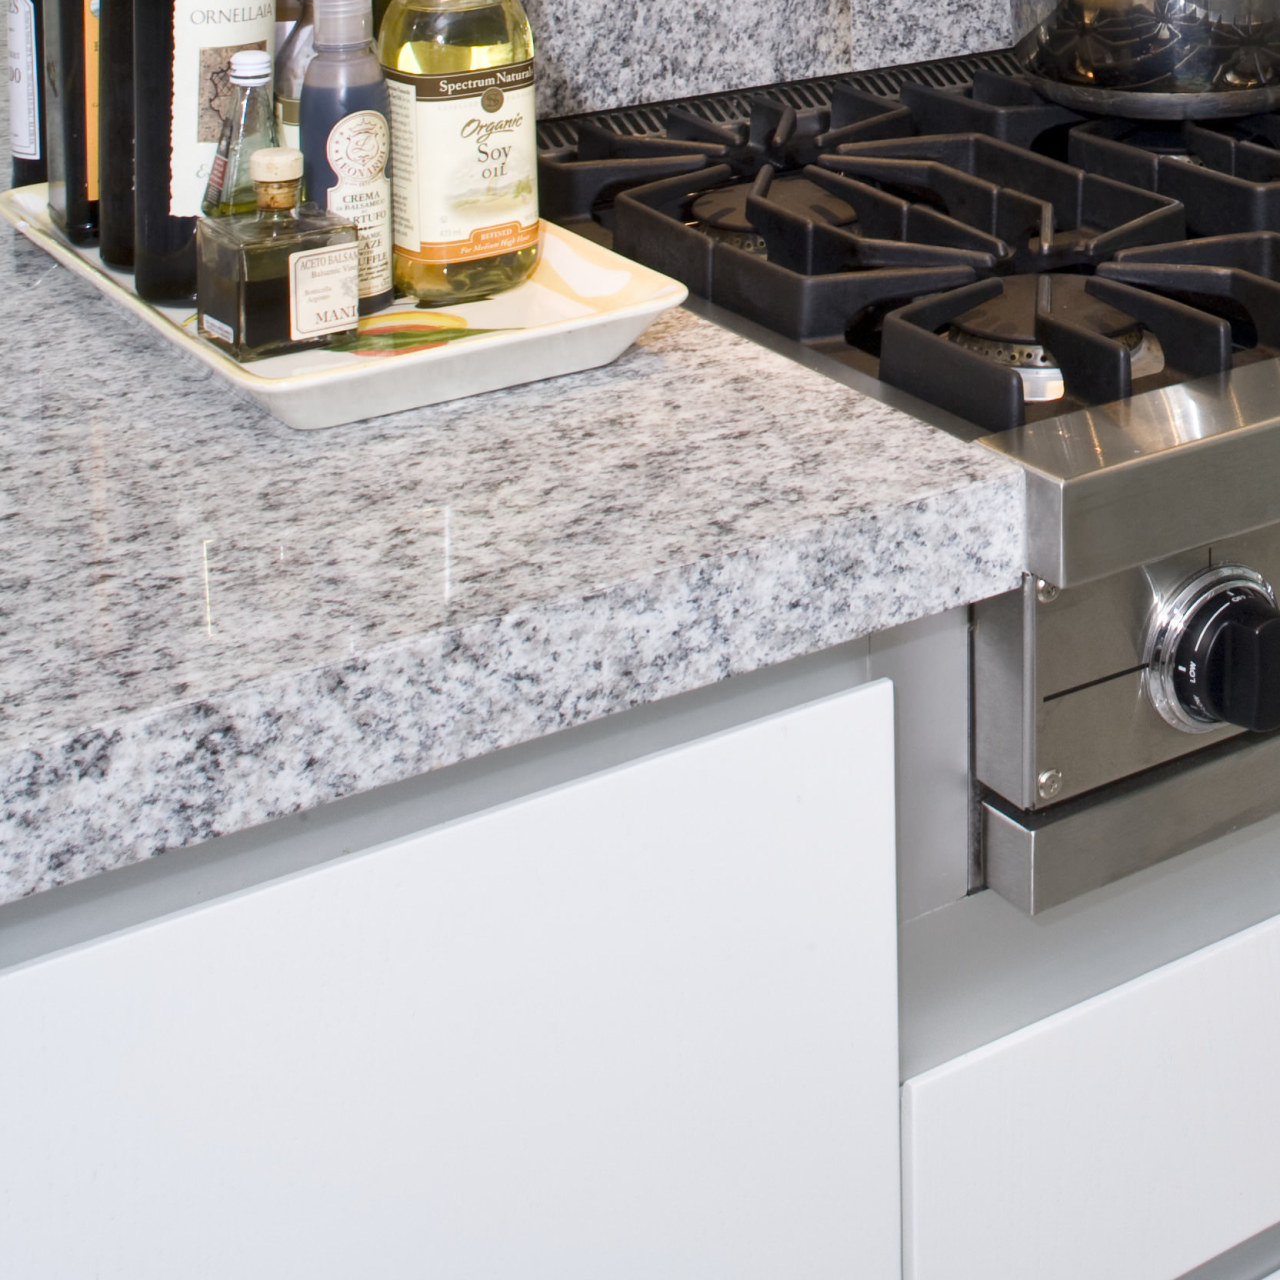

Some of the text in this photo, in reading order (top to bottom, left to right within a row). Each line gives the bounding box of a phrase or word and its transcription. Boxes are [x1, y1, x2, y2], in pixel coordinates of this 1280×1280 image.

[190, 3, 273, 25] ORNELLAIA
[439, 77, 495, 94] Spectrum
[460, 113, 524, 143] Organic
[477, 143, 512, 163] Soy
[342, 191, 380, 203] CREMA
[349, 210, 387, 224] RTUFO
[480, 228, 513, 241] REFINED
[1188, 660, 1197, 684] LOW
